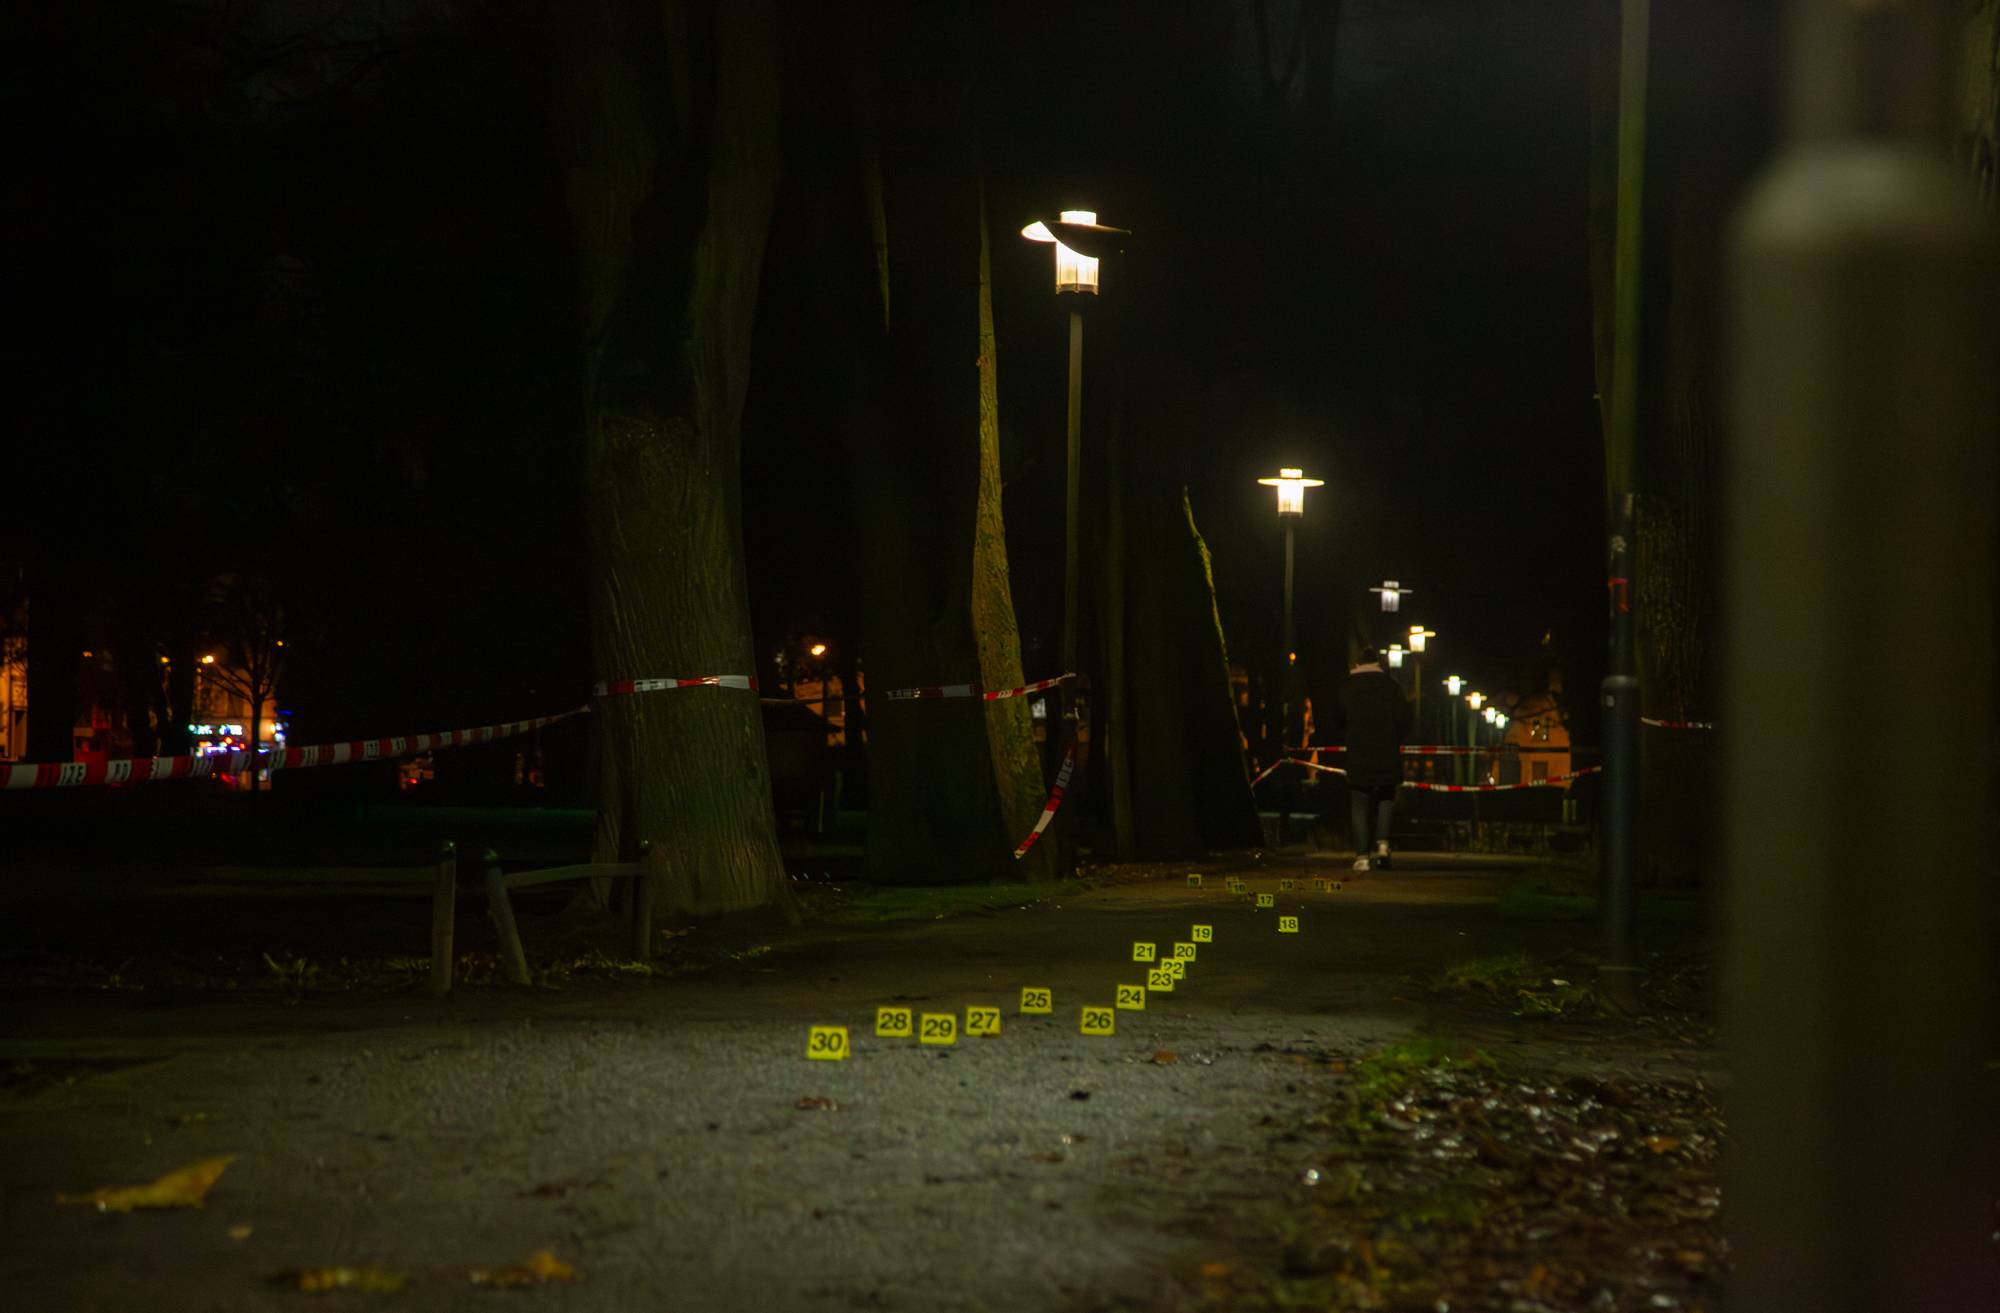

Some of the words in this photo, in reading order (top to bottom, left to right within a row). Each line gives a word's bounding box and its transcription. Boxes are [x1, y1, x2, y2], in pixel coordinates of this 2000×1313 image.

[1260, 895, 1273, 905] 17
[1281, 919, 1297, 930] 18
[1194, 927, 1211, 940] 19
[1135, 945, 1154, 958] 21
[1176, 945, 1195, 958] 20
[1163, 962, 1183, 974] 22
[1151, 972, 1173, 986] 23
[1024, 992, 1047, 1008] 25
[1119, 989, 1141, 1005] 24
[879, 1012, 908, 1030] 28
[970, 1012, 997, 1029] 27
[1084, 1011, 1111, 1029] 26
[924, 1019, 953, 1037] 29
[811, 1033, 843, 1052] 30
